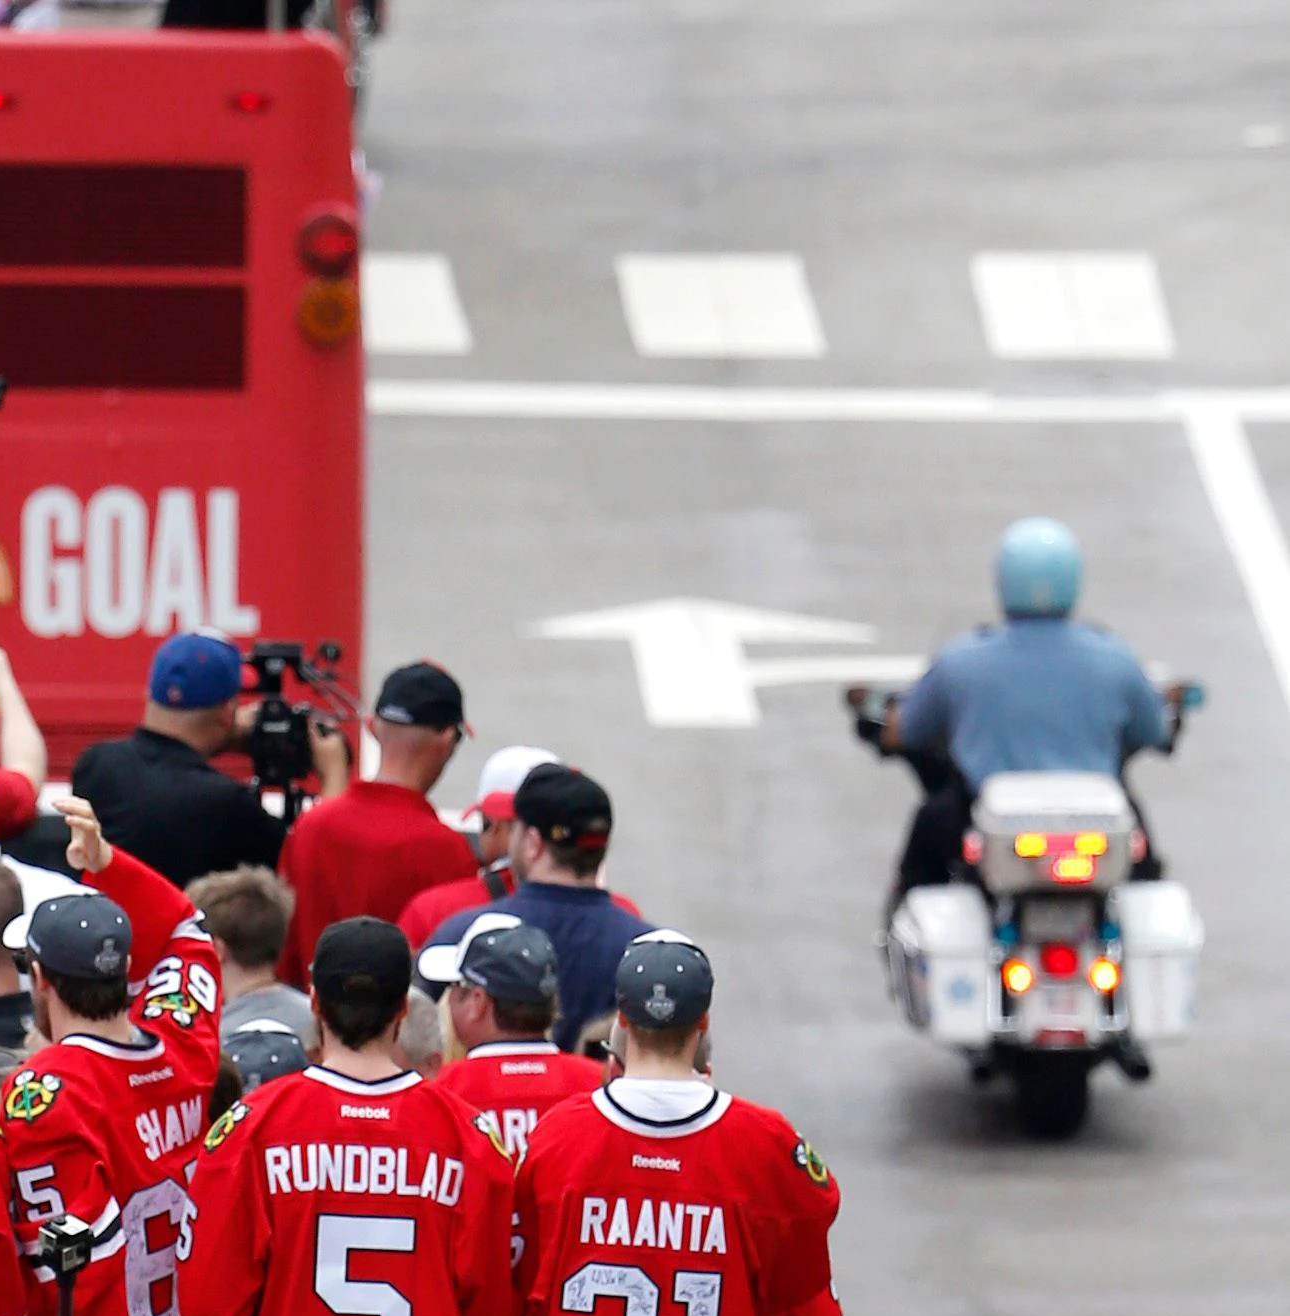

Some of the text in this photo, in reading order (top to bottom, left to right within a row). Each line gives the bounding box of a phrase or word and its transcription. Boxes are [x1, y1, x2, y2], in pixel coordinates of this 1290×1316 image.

[20, 485, 260, 638] GOAL
[128, 1066, 175, 1087] Reebok
[135, 1095, 202, 1161] SHAW
[340, 1104, 391, 1120] Reebok
[264, 1143, 464, 1207] RUNDBLAD
[632, 1154, 681, 1172] Reebok
[9, 1164, 65, 1223] 5
[580, 1198, 727, 1254] RAANTA
